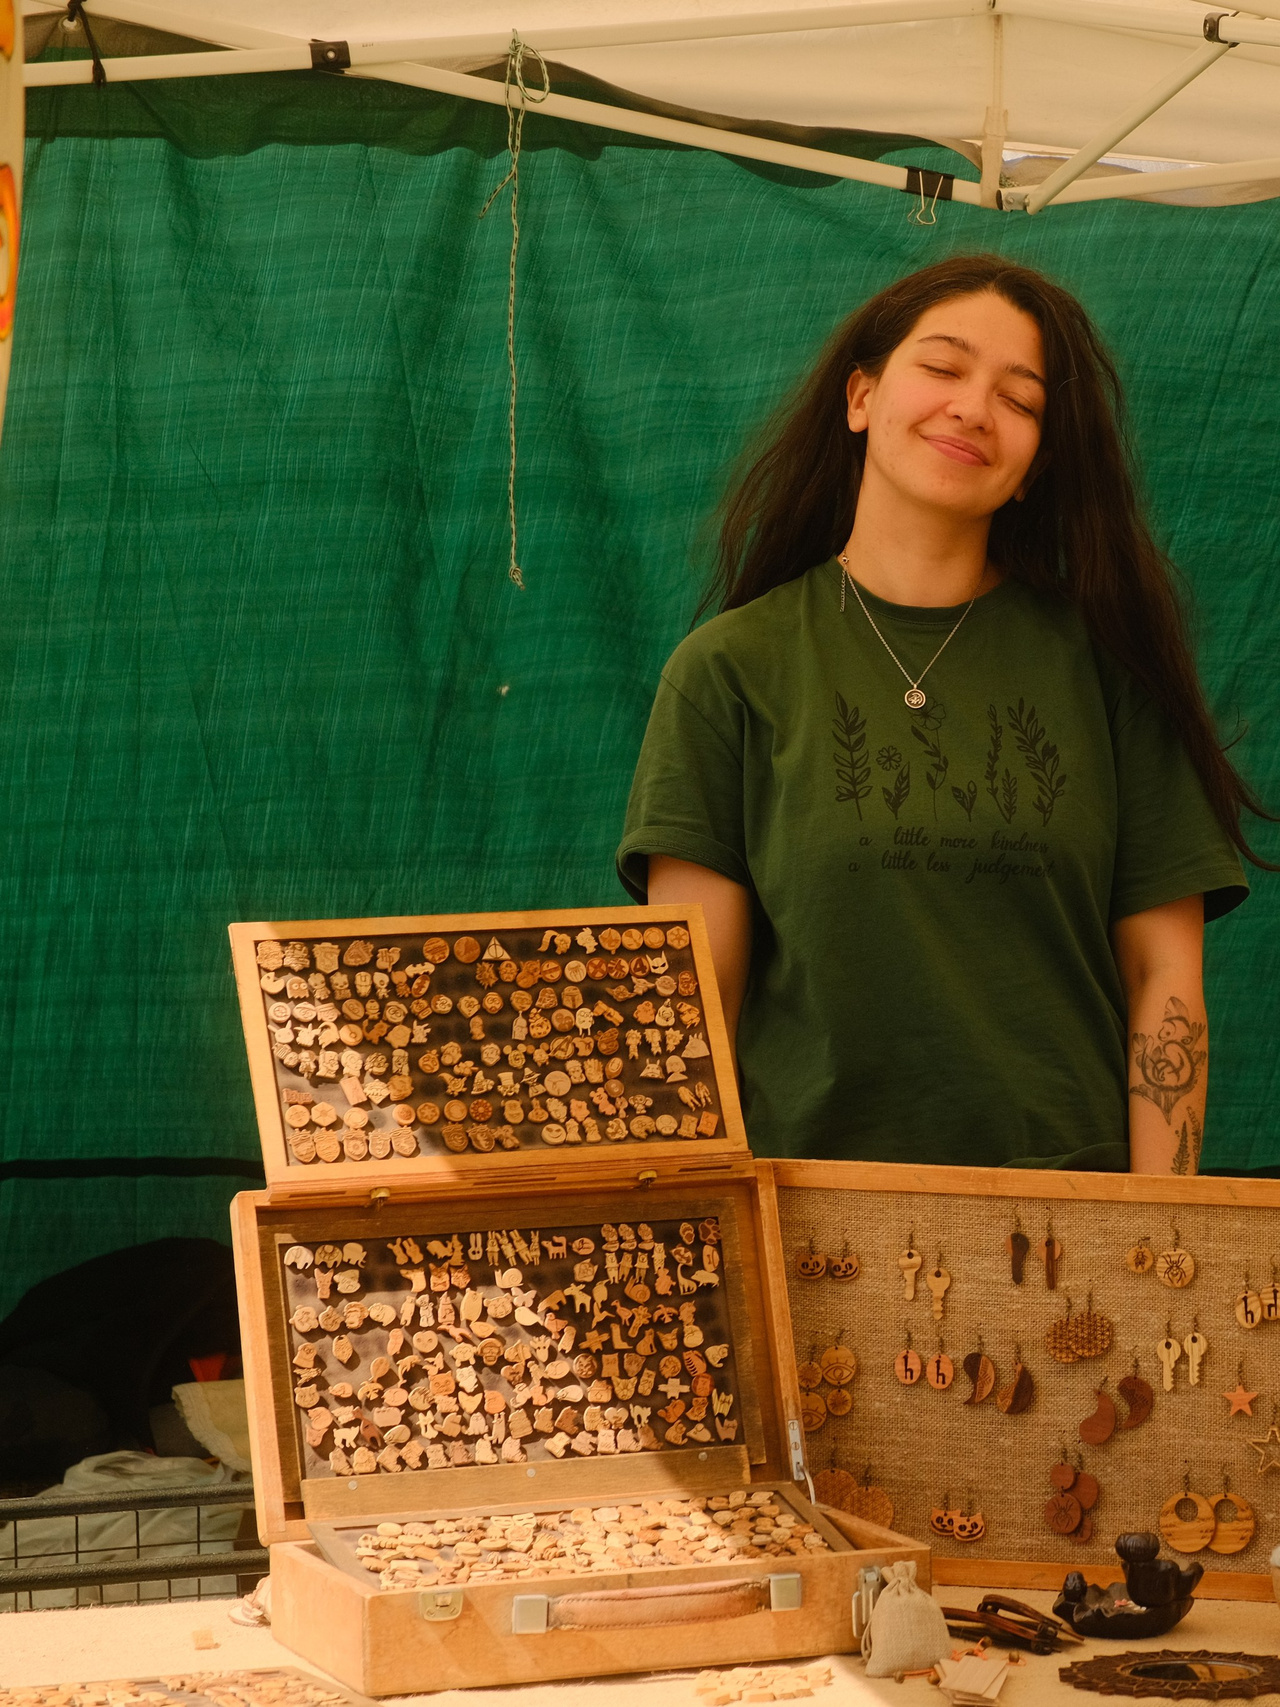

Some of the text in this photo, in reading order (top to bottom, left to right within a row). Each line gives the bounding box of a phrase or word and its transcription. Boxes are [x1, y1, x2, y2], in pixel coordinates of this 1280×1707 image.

[859, 825, 1050, 854] a little more kindness
[848, 849, 1056, 885] a little less judgemet
